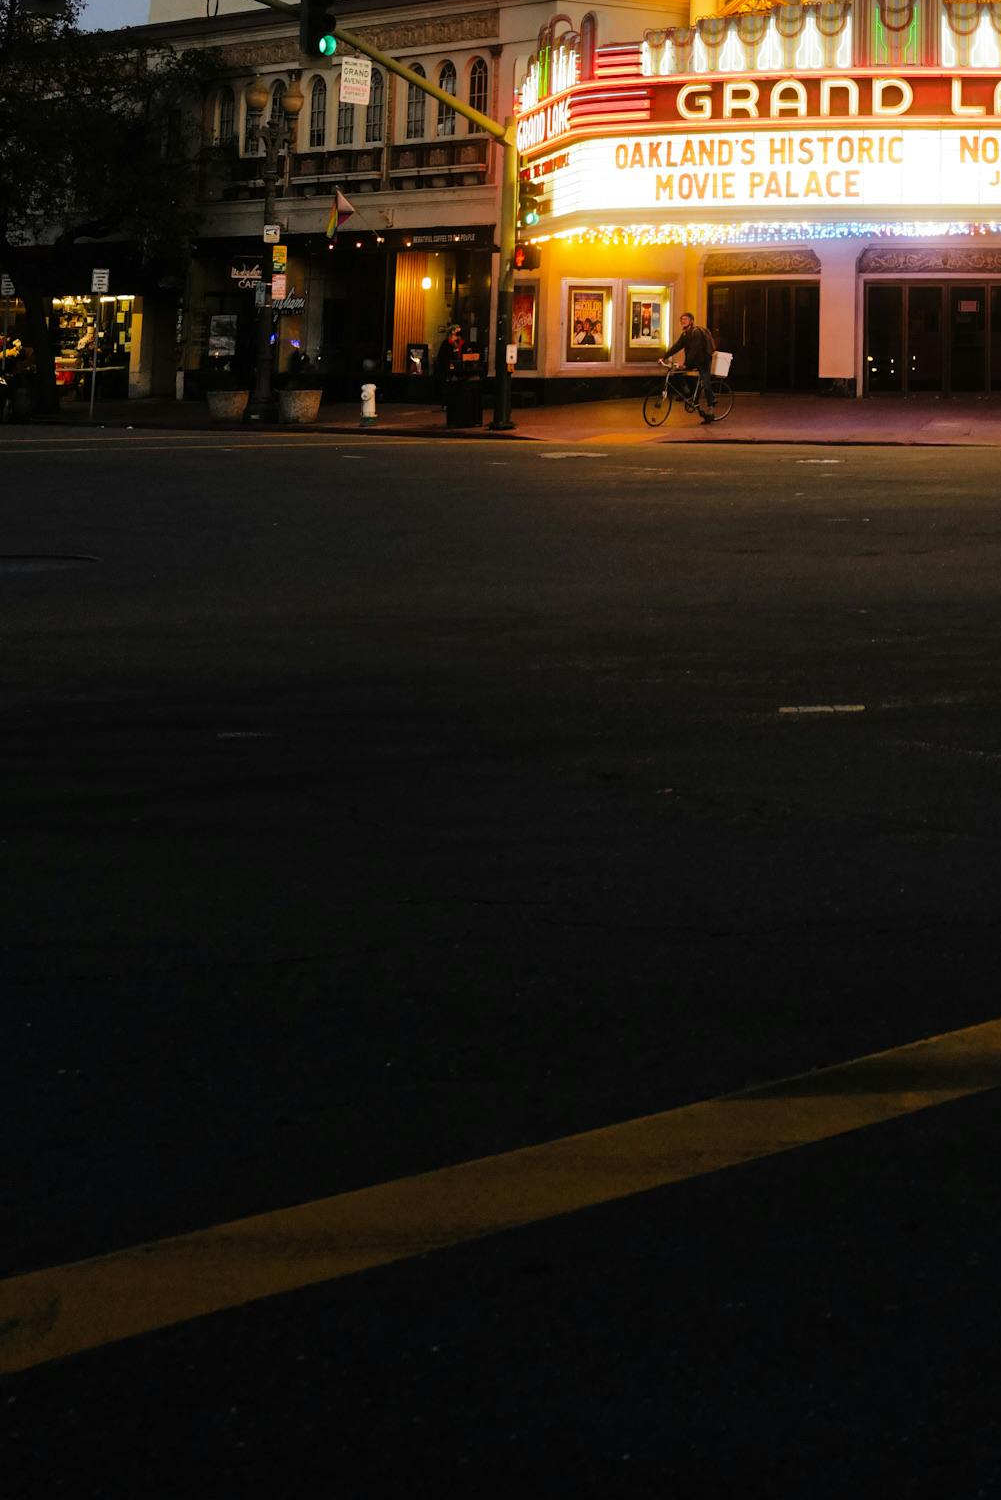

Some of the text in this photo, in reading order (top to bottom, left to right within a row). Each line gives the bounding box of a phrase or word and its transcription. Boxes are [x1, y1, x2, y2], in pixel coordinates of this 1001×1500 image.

[344, 68, 369, 77] GRAND
[344, 77, 368, 86] AVENUE
[677, 77, 913, 119] GRAND
[615, 135, 904, 169] OAKLAND'S HISTORIC
[655, 170, 861, 201] MOVIE PALACE
[238, 280, 259, 289] CAF
